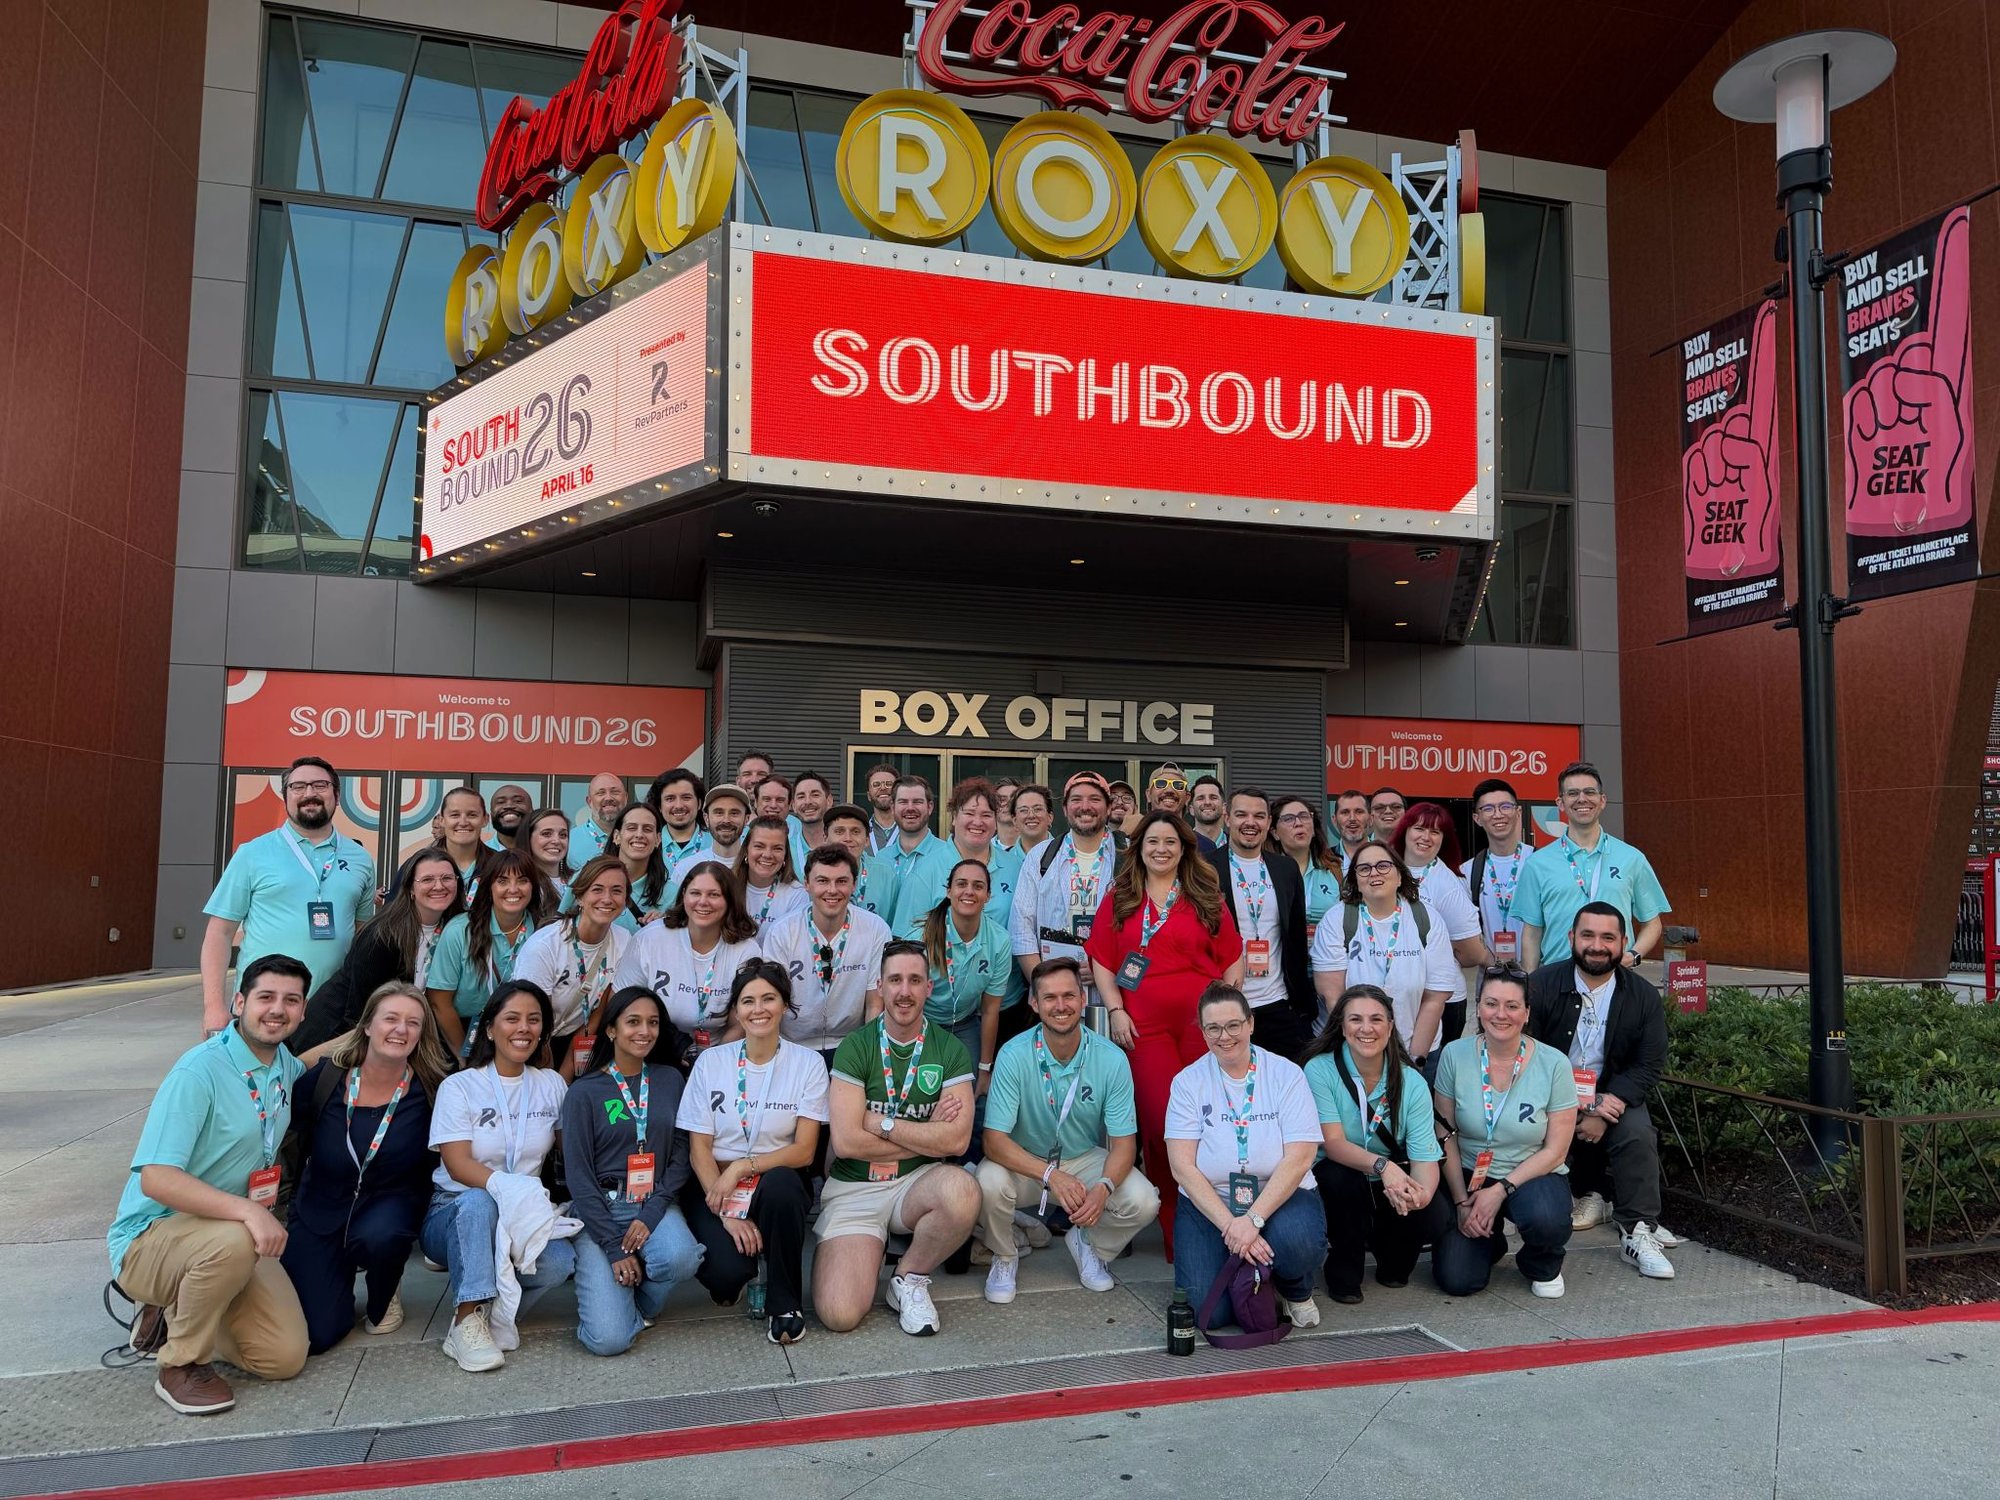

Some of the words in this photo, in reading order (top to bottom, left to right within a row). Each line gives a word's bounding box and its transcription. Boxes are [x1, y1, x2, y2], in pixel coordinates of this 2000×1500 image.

[878, 114, 1375, 278] ROXY
[463, 116, 714, 355] ROXY
[1843, 250, 1878, 286] BUY
[1846, 275, 1883, 311] AND
[1885, 255, 1928, 291] SELL
[1847, 286, 1915, 334] BRAVES
[639, 335, 675, 359] Presented
[676, 330, 686, 347] by
[1684, 331, 1710, 360] BUY
[1848, 317, 1900, 358] SEATS
[1686, 352, 1714, 381] AND
[1715, 338, 1748, 367] SELL
[809, 327, 1433, 450] SOUTHBOUND
[1686, 364, 1737, 402] BRAVES
[635, 399, 688, 430] RevPartners
[1687, 390, 1728, 422] SEATS
[442, 405, 520, 474] SOUTH
[521, 373, 592, 479] 26
[1872, 441, 1931, 471] SEAT
[440, 447, 519, 513] BOUND
[541, 474, 577, 501] APRIL
[580, 463, 594, 486] 16
[1867, 468, 1929, 496] GEEK
[1704, 498, 1749, 522] SEAT
[1701, 521, 1747, 545] GEEK
[1857, 552, 1887, 567] OFFICIAL
[1887, 546, 1912, 559] TICKET
[1912, 533, 1969, 553] MARKETPLACE
[1868, 564, 1879, 574] OF
[1879, 562, 1891, 572] THE
[1892, 554, 1925, 569] ATLANTA
[1925, 547, 1956, 562] BRAVES
[1694, 594, 1717, 606] OFFICIAL
[1717, 588, 1736, 600] TICKET
[1735, 578, 1777, 597] MARKETPLACE
[1703, 603, 1711, 613] OF
[1711, 601, 1720, 611] THE
[1721, 595, 1746, 608] ATLANTA
[1746, 590, 1768, 602] BRAVES
[438, 693, 495, 705] Welcome
[497, 696, 511, 706] to
[288, 705, 658, 748] SOUTHBOUND26
[860, 689, 990, 738] BOX
[1004, 695, 1215, 746] OFFICE
[1391, 731, 1432, 741] Welcome
[1433, 733, 1443, 741] to
[1326, 744, 1548, 775] UTHBOUND26
[1672, 980, 1691, 990] System
[1691, 978, 1704, 987] FDC
[1676, 966, 1700, 977] Sprinkler
[1677, 995, 1686, 1003] The
